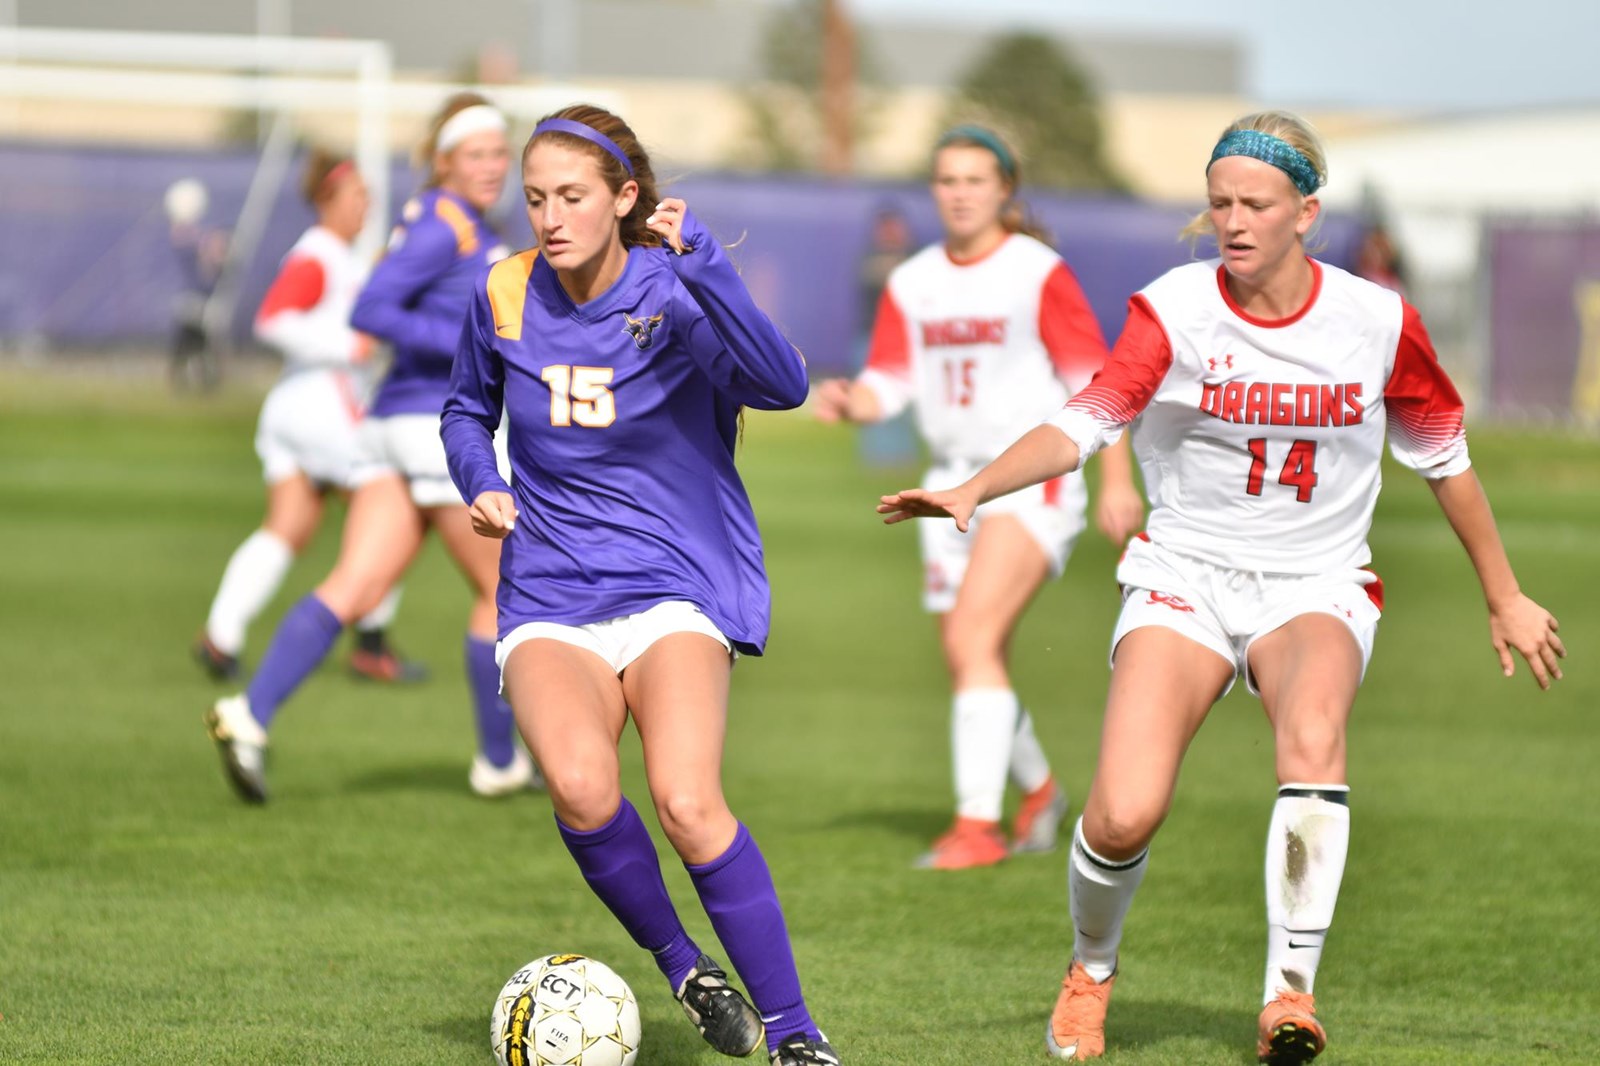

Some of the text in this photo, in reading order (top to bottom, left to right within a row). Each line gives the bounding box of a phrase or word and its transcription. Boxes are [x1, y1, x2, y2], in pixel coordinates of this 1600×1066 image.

[541, 364, 616, 428] 15
[944, 359, 976, 407] 15
[1200, 381, 1364, 427] DRAGONS
[1246, 438, 1318, 503] 14
[550, 1027, 569, 1043] FIFA
